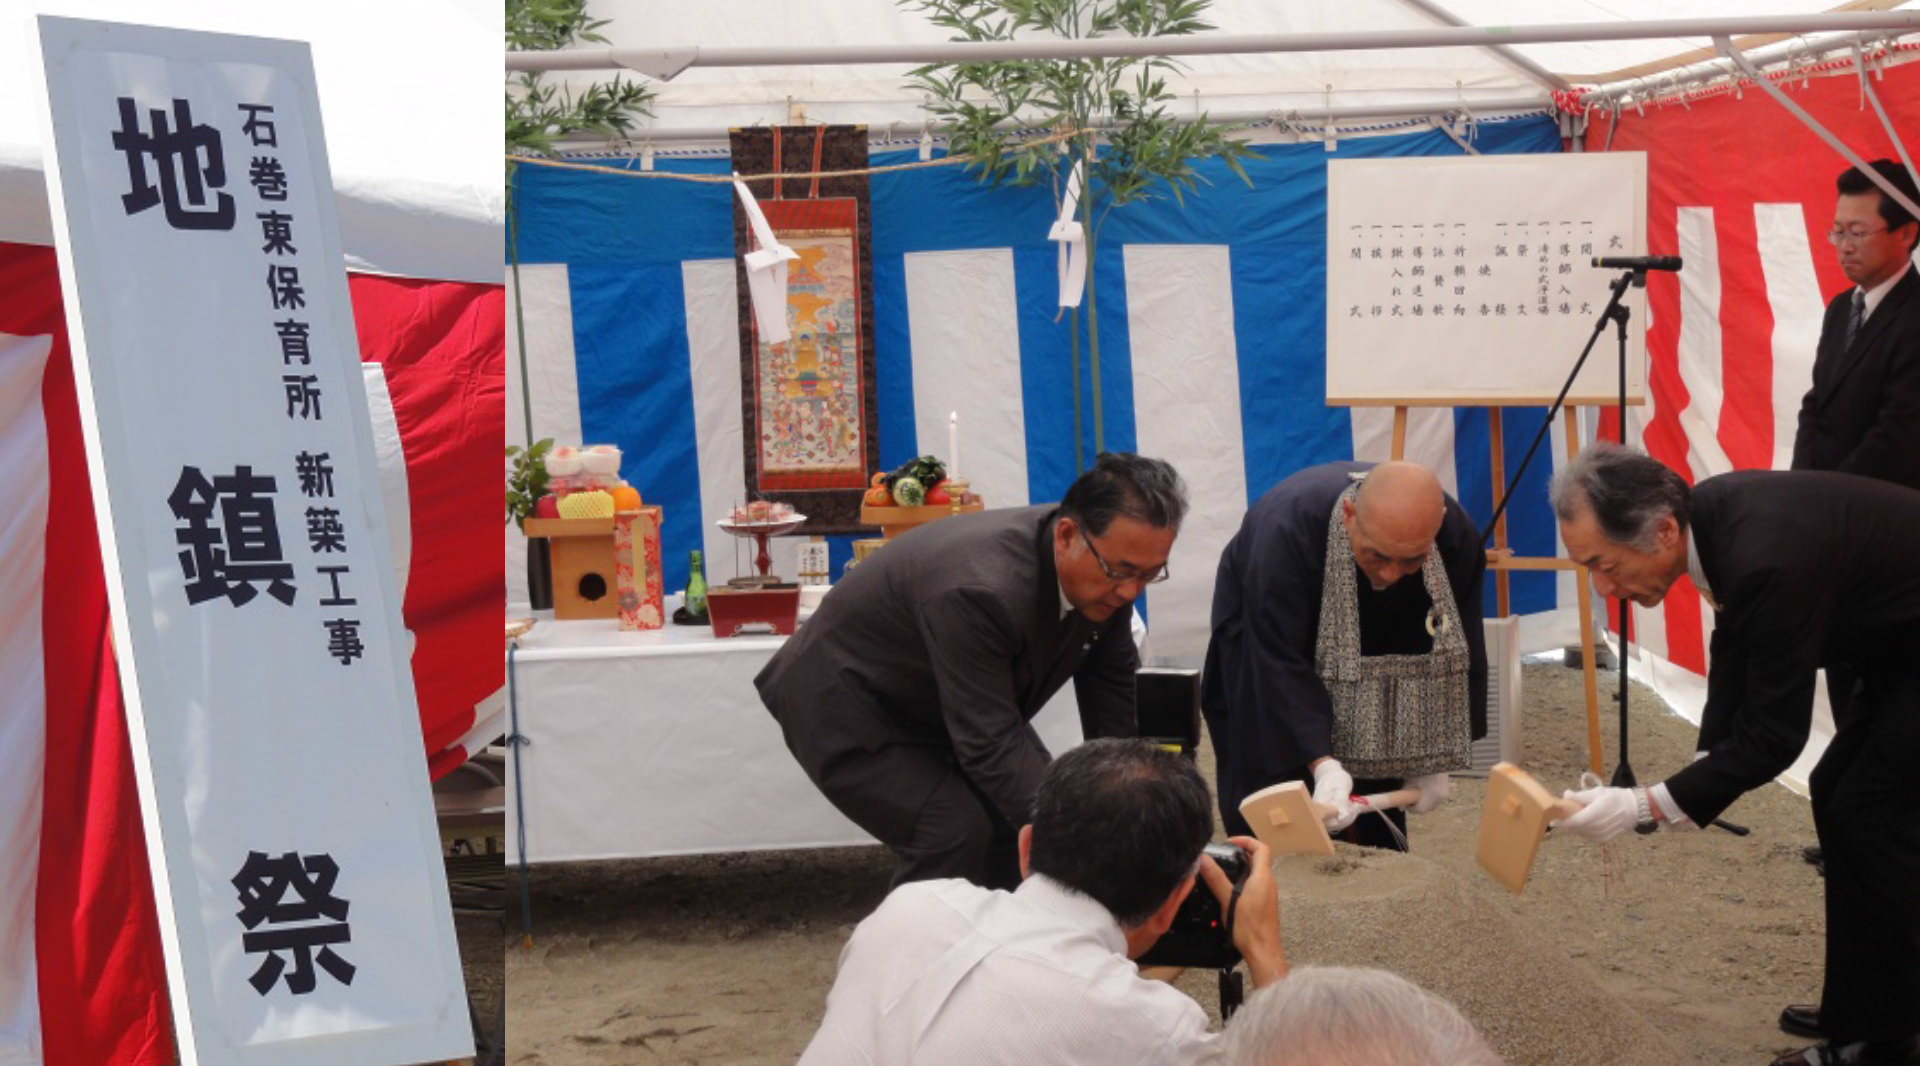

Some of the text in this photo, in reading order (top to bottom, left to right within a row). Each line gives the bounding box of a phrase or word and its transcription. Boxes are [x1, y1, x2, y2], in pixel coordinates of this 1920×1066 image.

[111, 96, 357, 998] 地鎮祭
[238, 102, 366, 667] 石巻東保育所 新築工事
